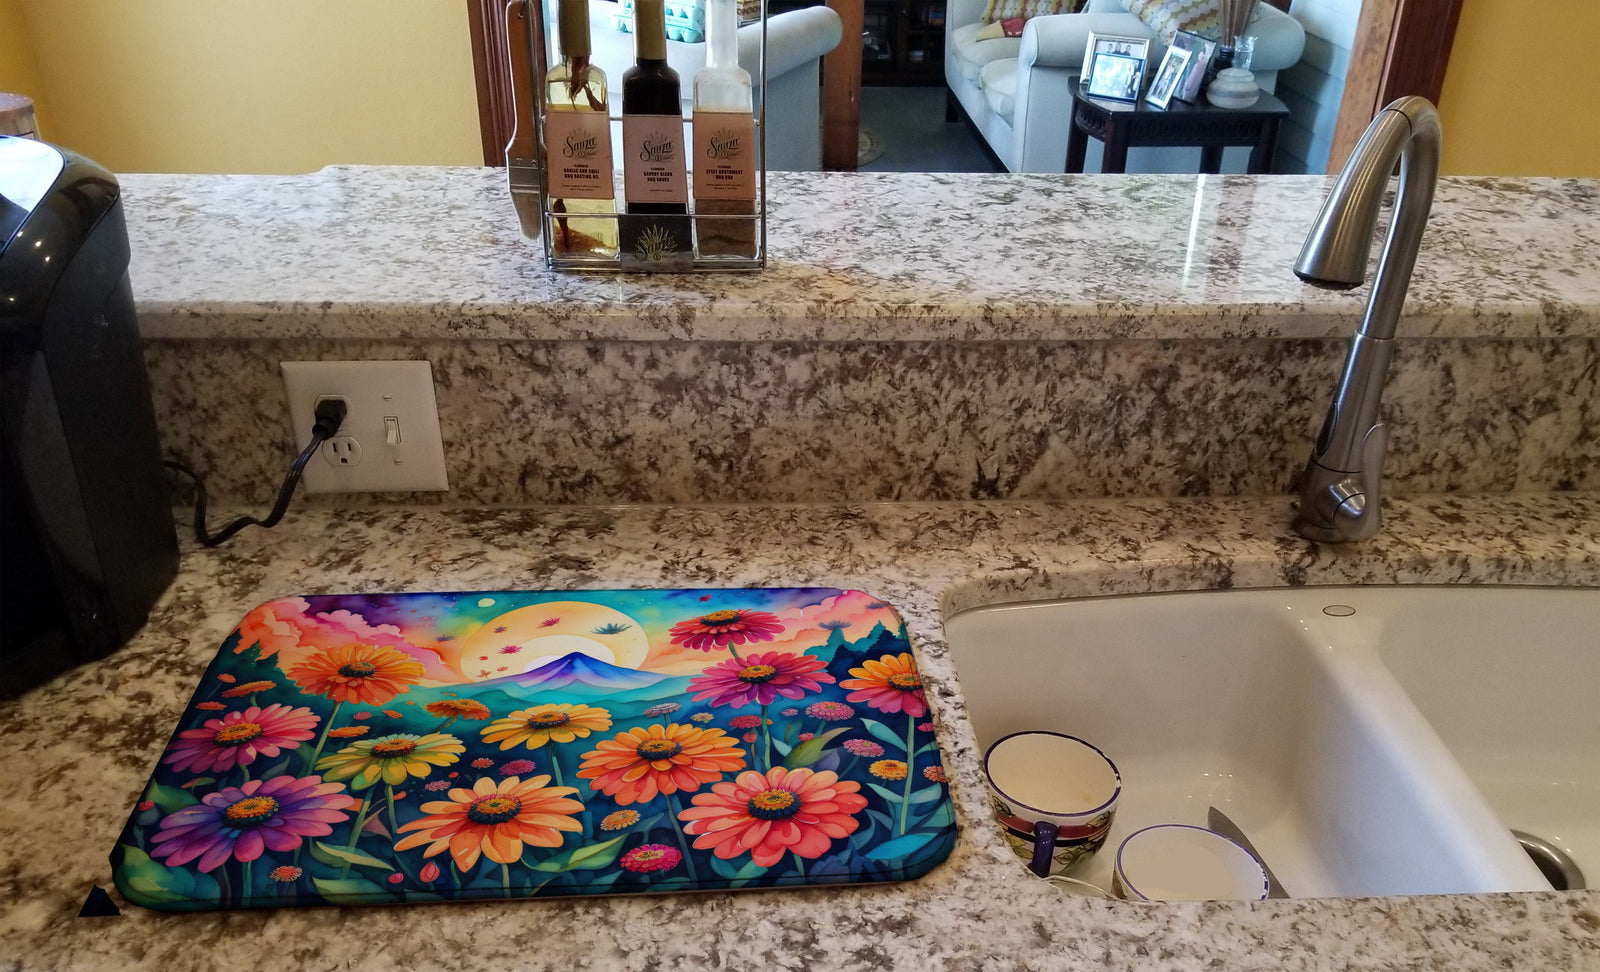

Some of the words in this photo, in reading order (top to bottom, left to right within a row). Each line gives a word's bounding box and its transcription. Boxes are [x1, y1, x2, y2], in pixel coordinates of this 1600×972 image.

[563, 136, 597, 158] Sauza
[640, 140, 674, 162] Sauza
[707, 136, 739, 158] Sauza
